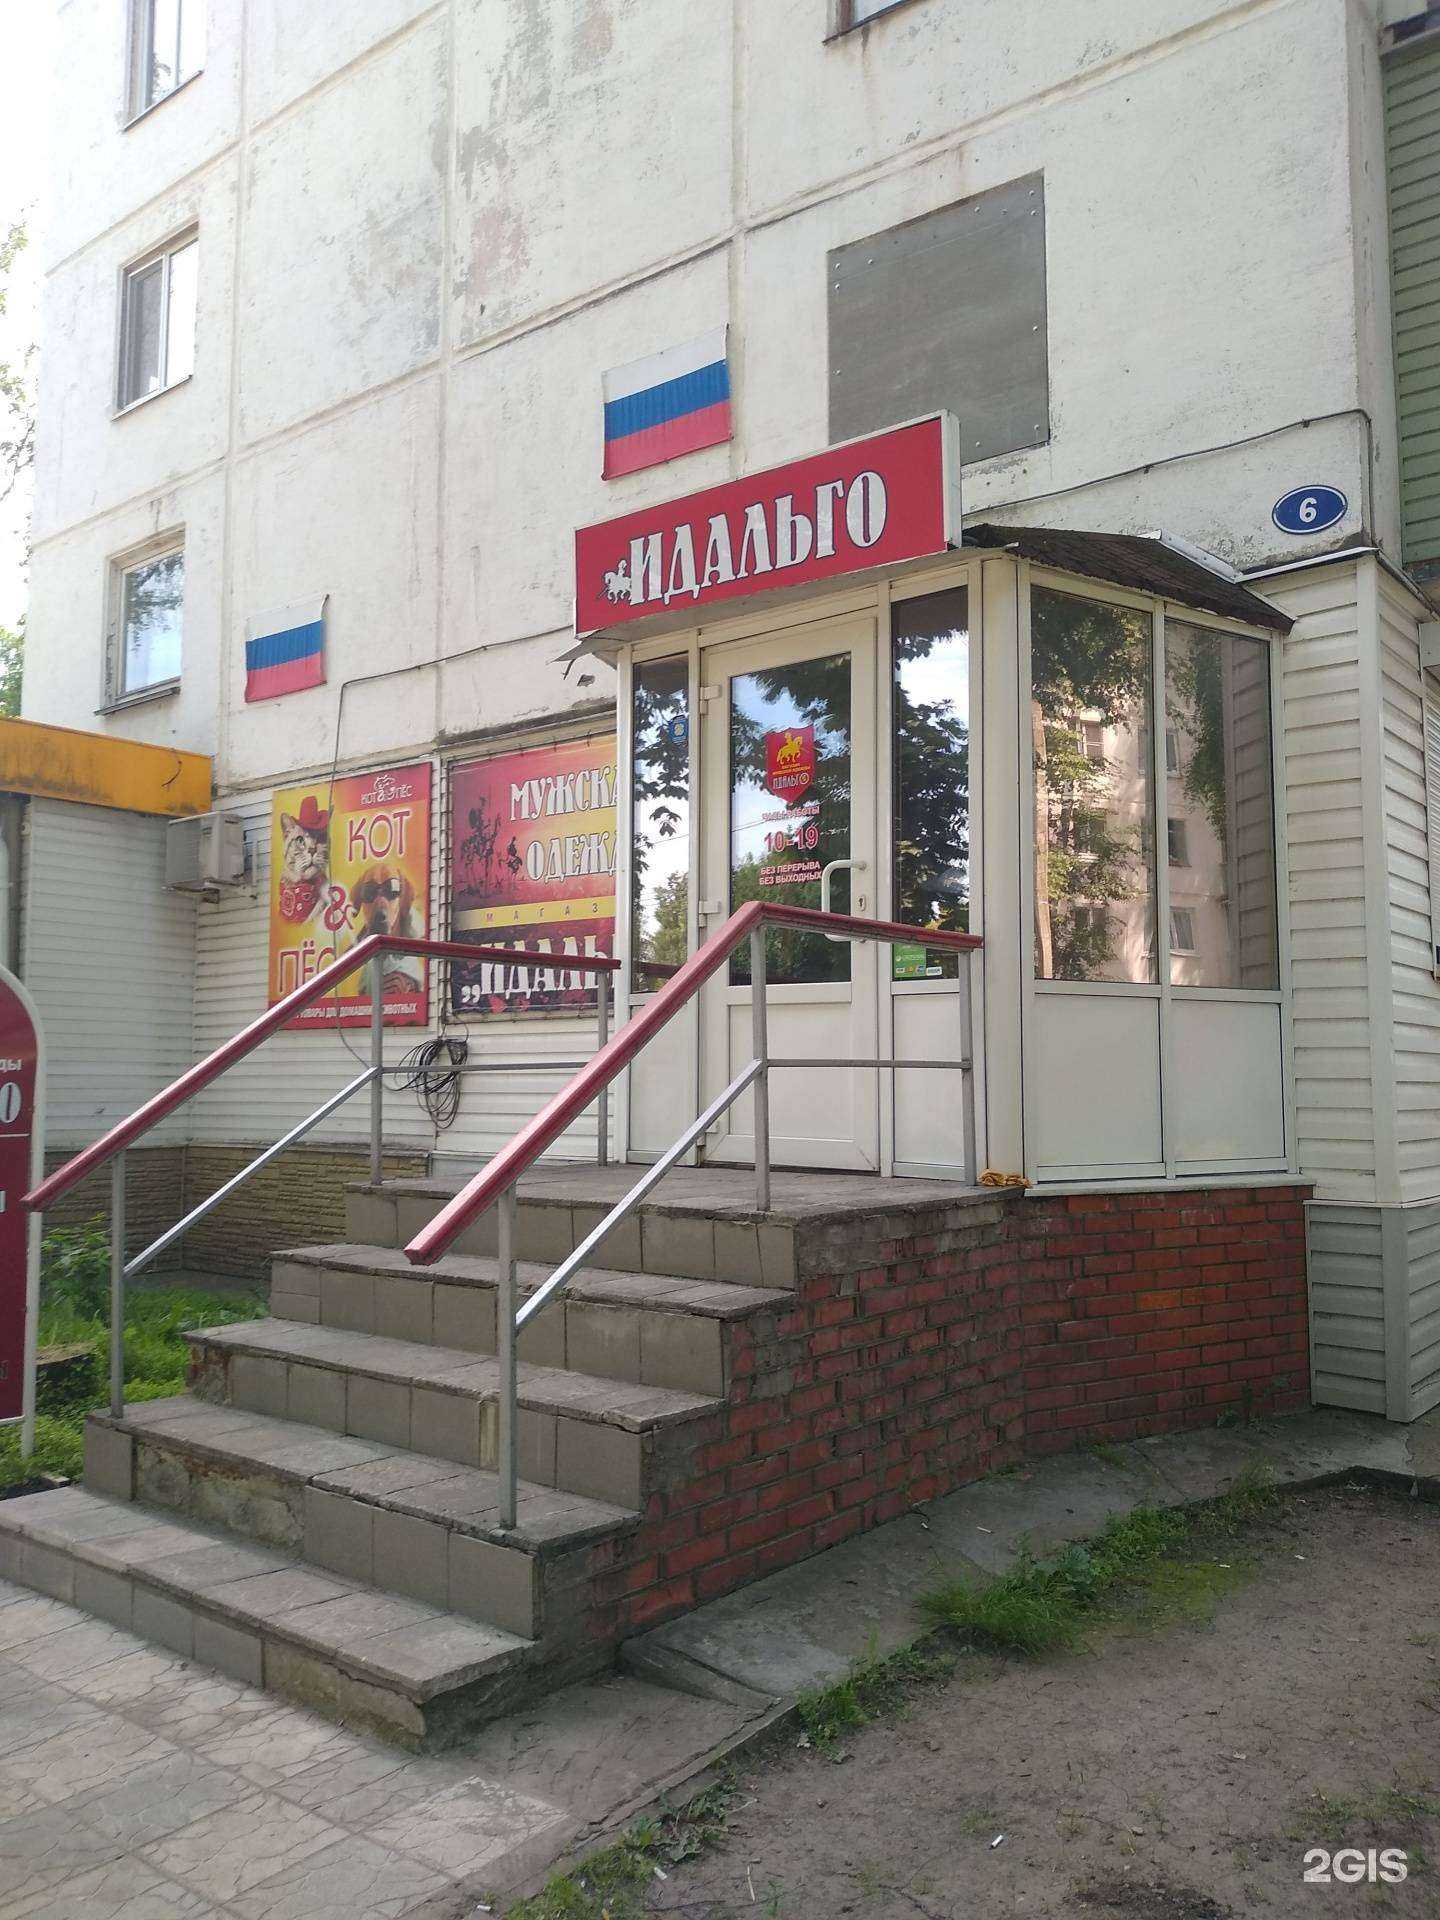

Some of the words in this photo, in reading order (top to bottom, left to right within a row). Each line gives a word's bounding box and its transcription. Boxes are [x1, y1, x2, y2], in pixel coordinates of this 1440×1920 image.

[1299, 497, 1318, 523] 6
[629, 471, 887, 605] ИДАЛЬГО
[509, 764, 618, 821] МУЖСК
[348, 809, 411, 863] КОТ
[764, 825, 819, 853] 10-19
[759, 876, 775, 885] БЕЗ
[776, 871, 822, 883] ВЫХОДНЫХ
[760, 867, 776, 875] БЕЗ
[777, 861, 820, 874] ПЕРЕРЫВА
